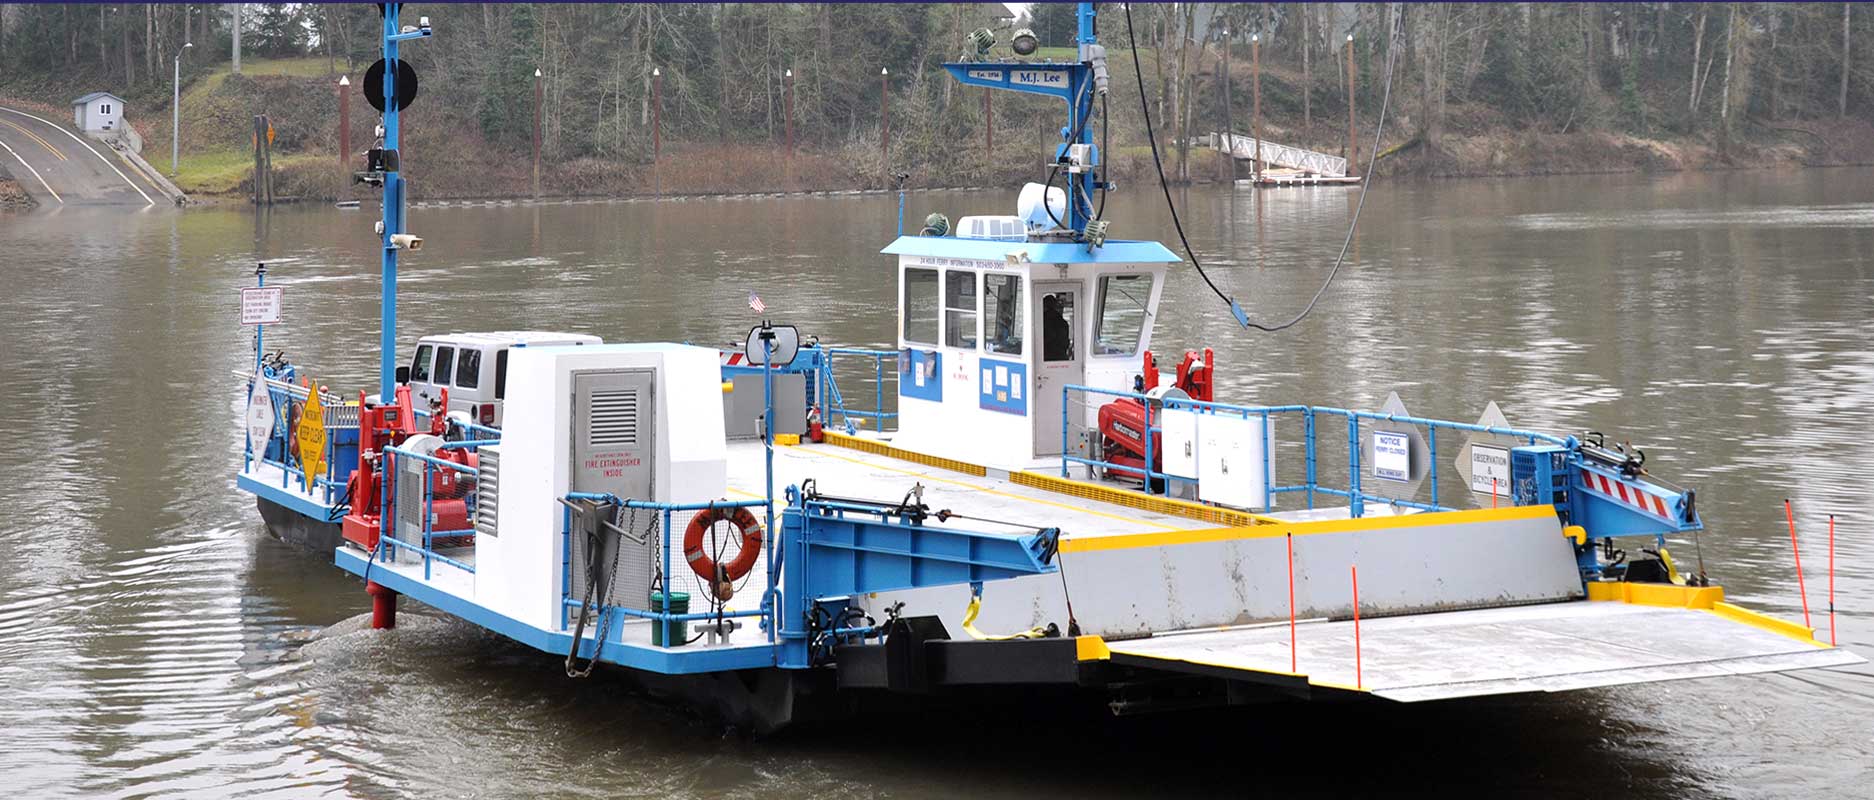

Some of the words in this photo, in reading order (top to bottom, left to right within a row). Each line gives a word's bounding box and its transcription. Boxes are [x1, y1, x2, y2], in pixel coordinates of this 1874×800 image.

[1020, 72, 1040, 84] M.J.
[1044, 73, 1060, 82] Lee
[310, 428, 323, 444] CLEAR
[1380, 437, 1401, 446] NOTICE
[1389, 447, 1406, 455] CLOSED
[585, 460, 598, 469] FIRE
[600, 458, 641, 468] EXTINGUISHER
[1473, 453, 1507, 466] OBSERVATION
[603, 469, 623, 478] INSIDE
[1487, 466, 1493, 475] &
